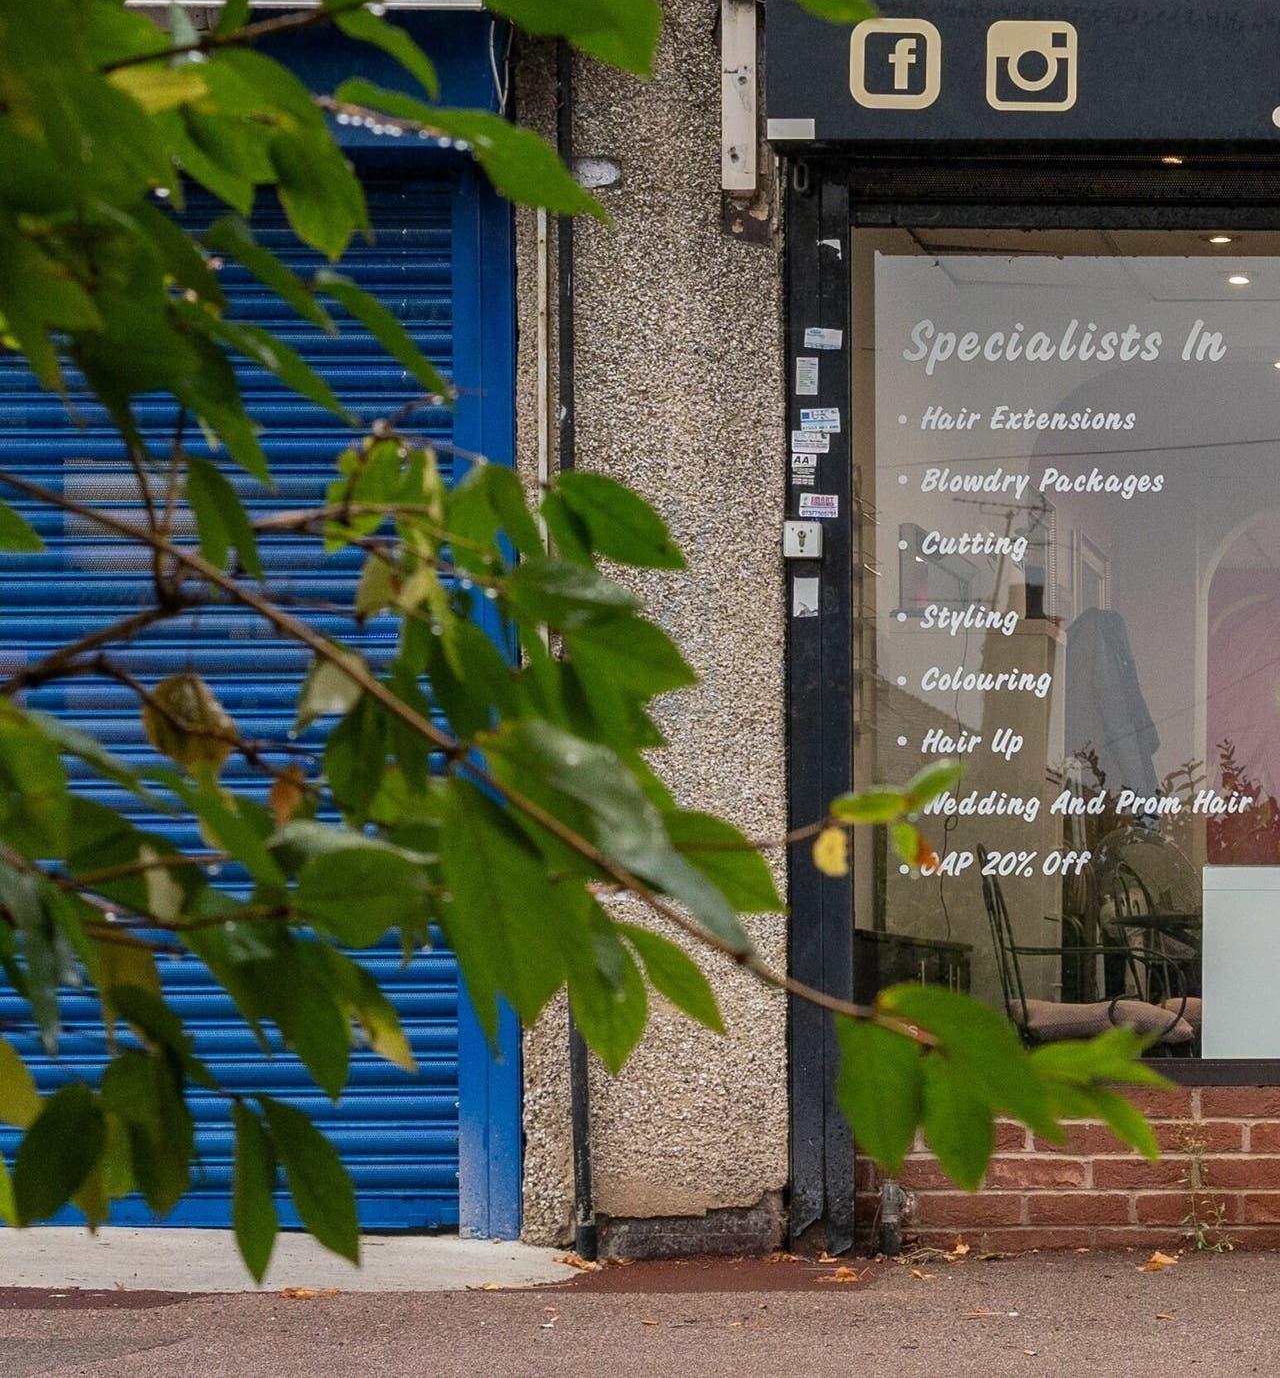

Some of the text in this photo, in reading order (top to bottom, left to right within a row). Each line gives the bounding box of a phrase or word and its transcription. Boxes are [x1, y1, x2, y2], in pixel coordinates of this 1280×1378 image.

[903, 318, 1163, 376] Specialists
[1181, 319, 1228, 363] In
[920, 405, 1137, 431] Hair Extensions
[920, 467, 1165, 500] Blowdry Packages
[921, 530, 1029, 562] Cutting
[920, 603, 1019, 636] Styling
[921, 666, 1053, 699] Colouring
[921, 728, 1024, 761] Hair Up
[924, 789, 1254, 823] Wedding And Prom Hair
[981, 850, 1038, 878] 20%
[1042, 850, 1092, 878] Off
